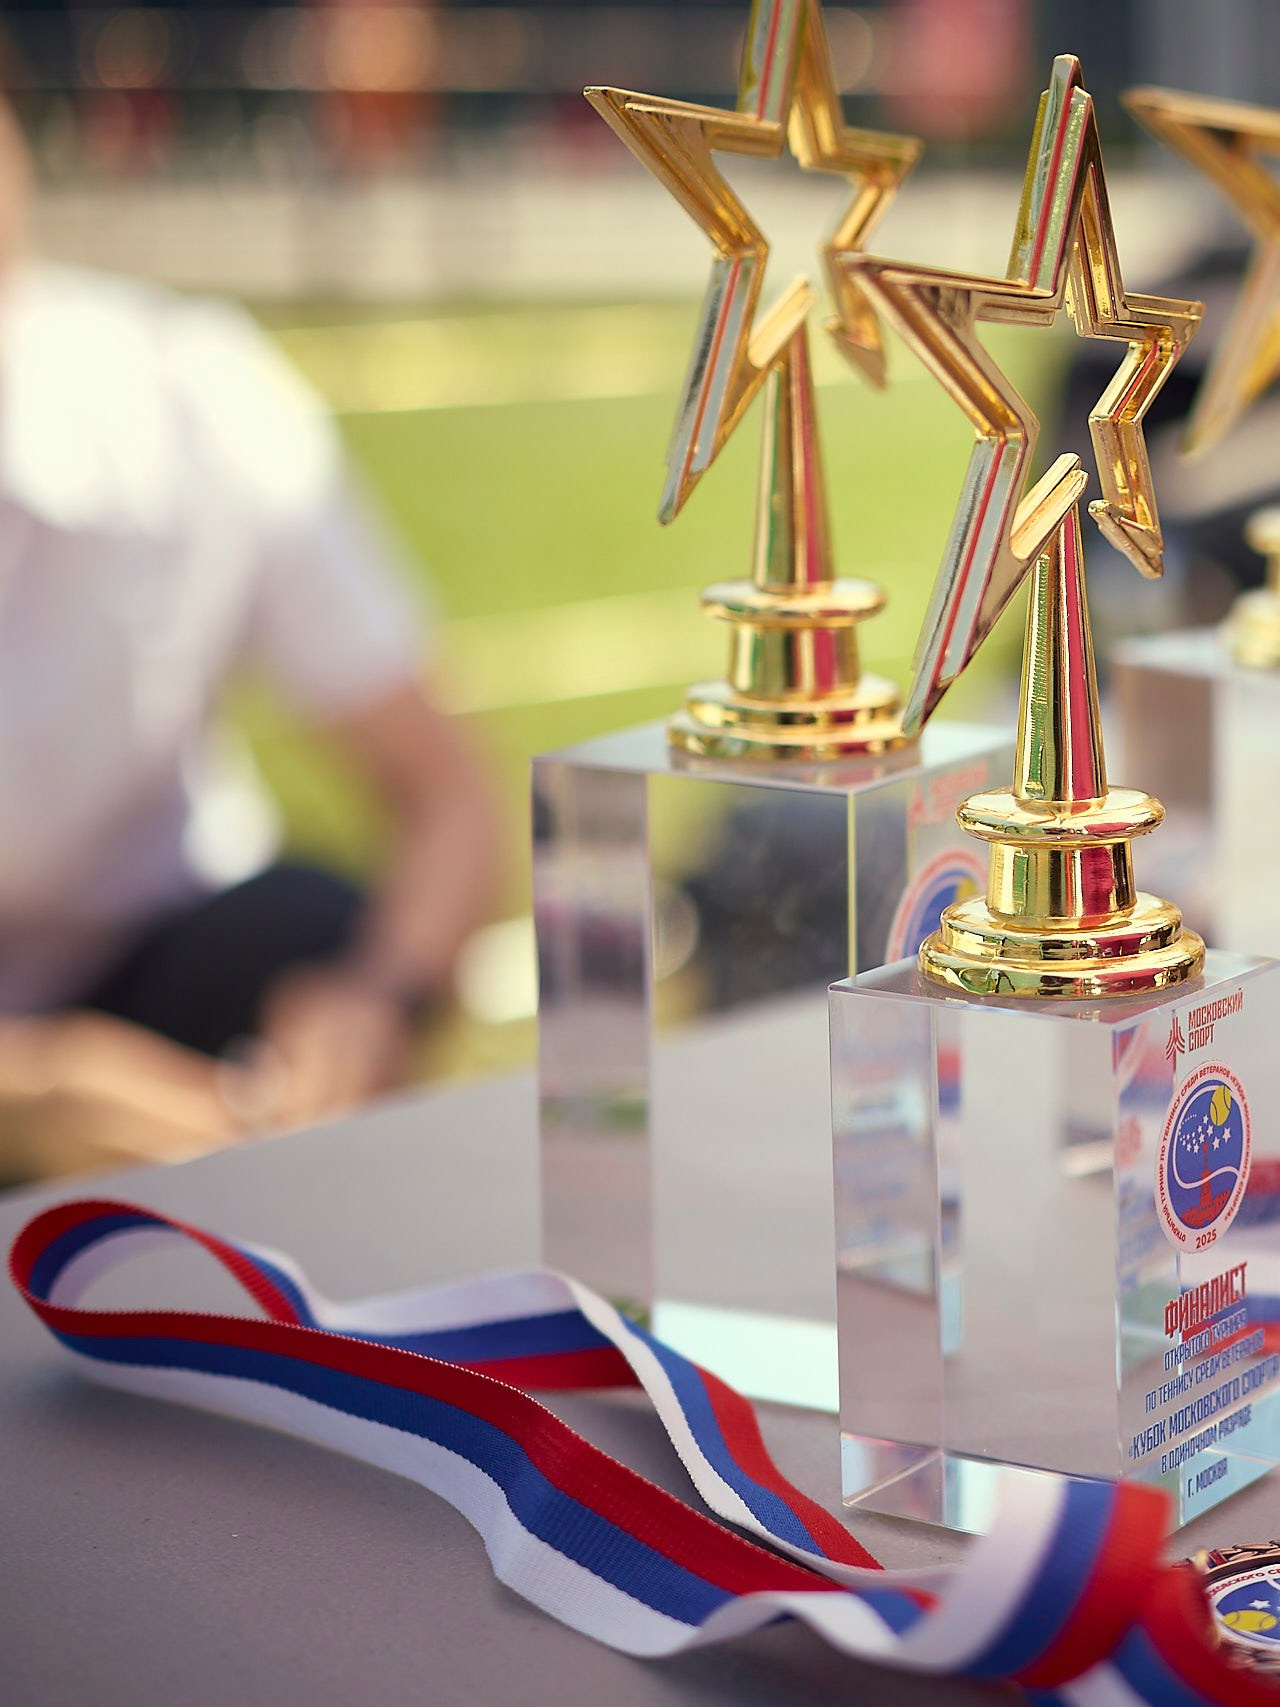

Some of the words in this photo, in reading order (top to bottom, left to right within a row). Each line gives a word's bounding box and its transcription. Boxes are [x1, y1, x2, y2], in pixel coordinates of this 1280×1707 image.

[1188, 987, 1244, 1031] МОСКОВСКИЙ
[1188, 1024, 1215, 1052] СПОРТ
[1163, 1095, 1181, 1142] ТЕННИСУ
[1180, 1073, 1199, 1098] СРЕДИ
[1199, 1065, 1231, 1079] ВЕТЕРАНОВ
[1195, 1229, 1218, 1250] 2025
[1164, 1262, 1247, 1338] ФИНАЛИСТ
[1164, 1329, 1210, 1372] ОТКРЫТОГО
[1145, 1391, 1157, 1413] ПО
[1158, 1371, 1193, 1406] ТЕННИСУ
[1195, 1354, 1221, 1385] СРЕДИ
[1128, 1418, 1167, 1461] «КУБОК
[1169, 1377, 1239, 1440] МОСКОВСКОГО
[1161, 1452, 1168, 1474] В
[1169, 1424, 1217, 1470] ОДИНОЧНОМ
[1187, 1478, 1195, 1499] Г.
[1195, 1457, 1228, 1494] МОСКВА
